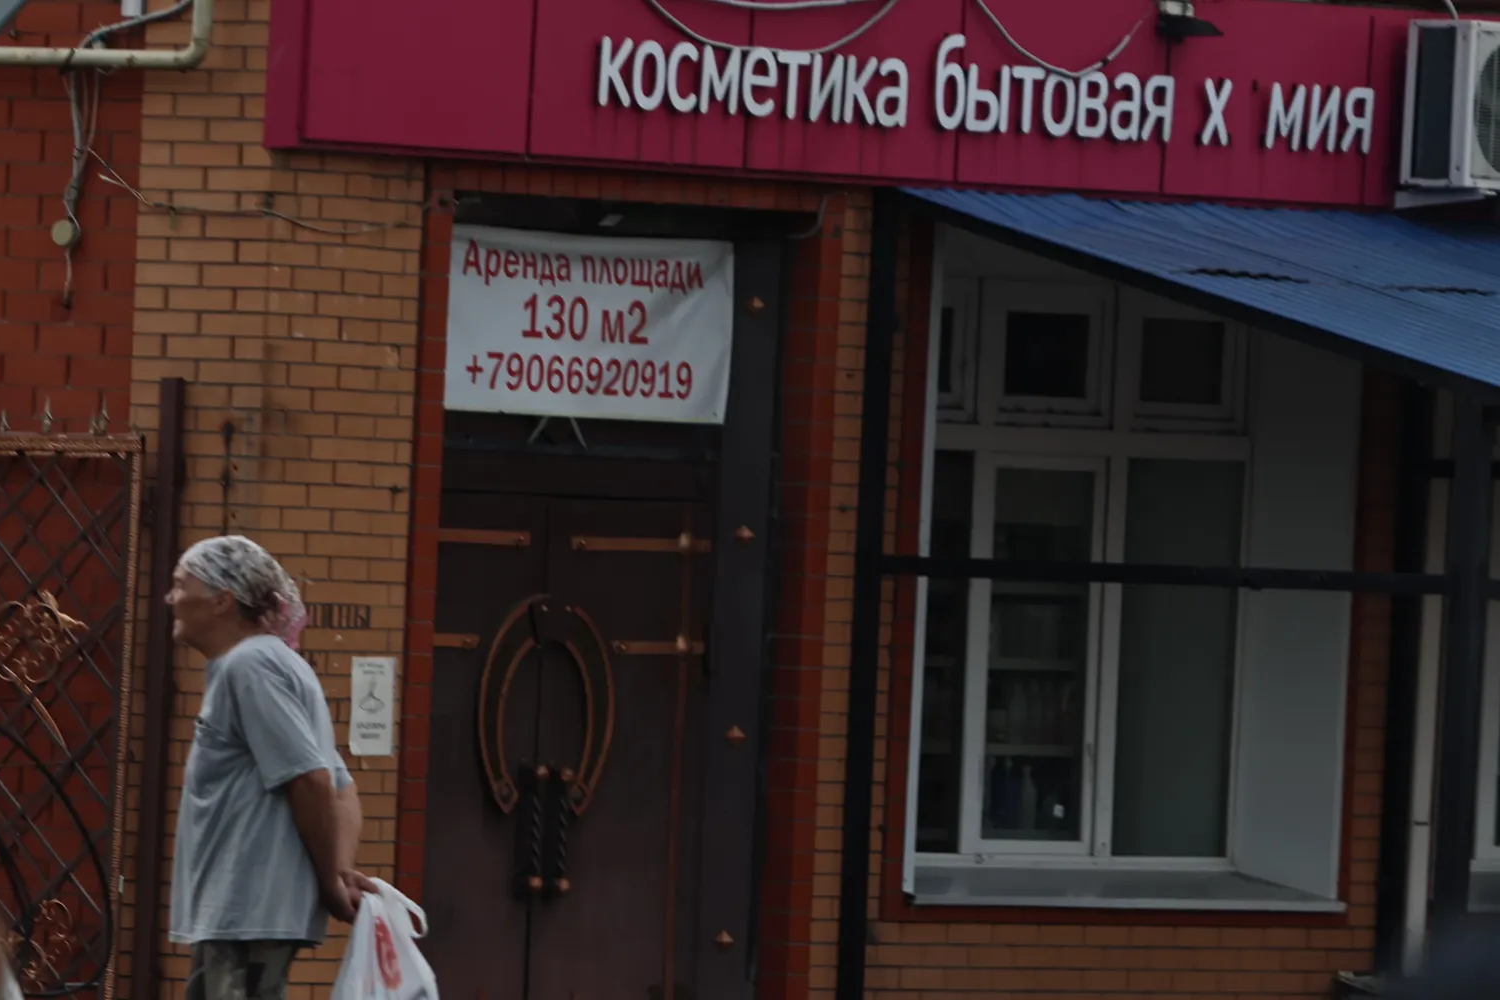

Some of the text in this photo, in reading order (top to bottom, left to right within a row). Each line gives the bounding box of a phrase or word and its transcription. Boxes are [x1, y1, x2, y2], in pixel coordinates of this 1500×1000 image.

[935, 33, 1175, 144] бытовая
[462, 238, 705, 295] Аренда площади
[521, 293, 589, 342] 130
[465, 351, 694, 400] +79066920919
